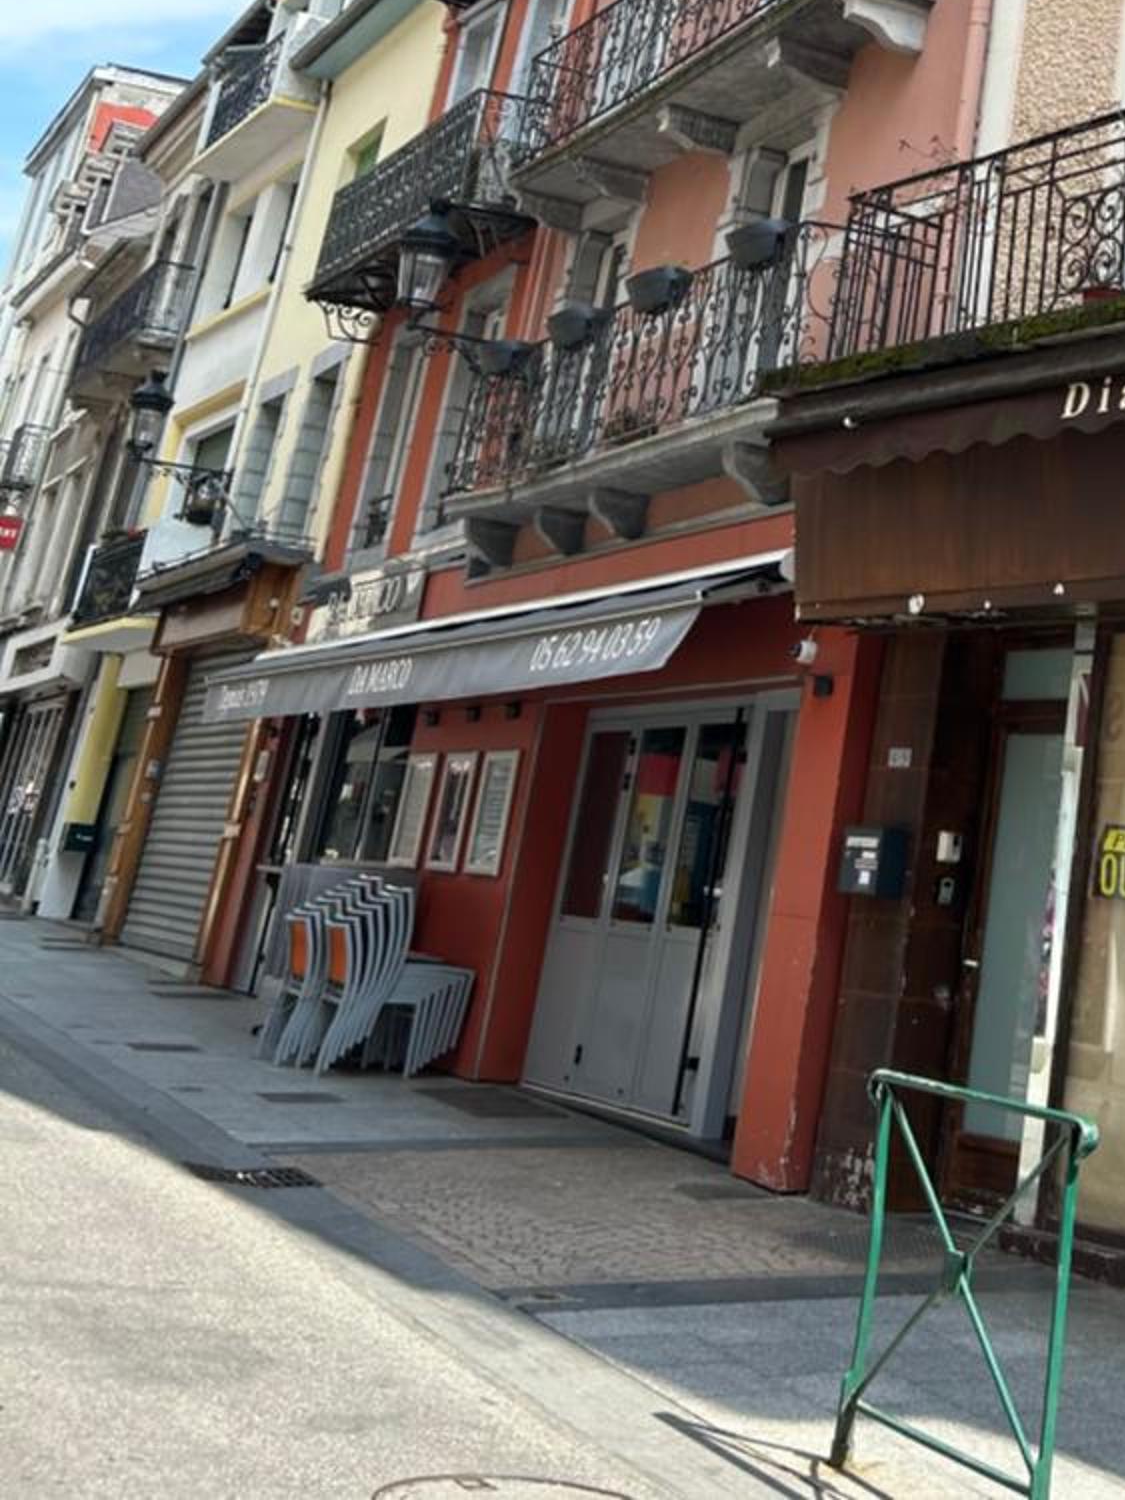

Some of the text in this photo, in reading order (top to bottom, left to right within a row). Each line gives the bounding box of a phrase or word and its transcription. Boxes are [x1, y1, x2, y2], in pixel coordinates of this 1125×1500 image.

[530, 636, 559, 672] 05
[552, 630, 582, 669] 62
[577, 628, 608, 664] 94
[602, 623, 635, 661] 03
[626, 616, 662, 657] 59
